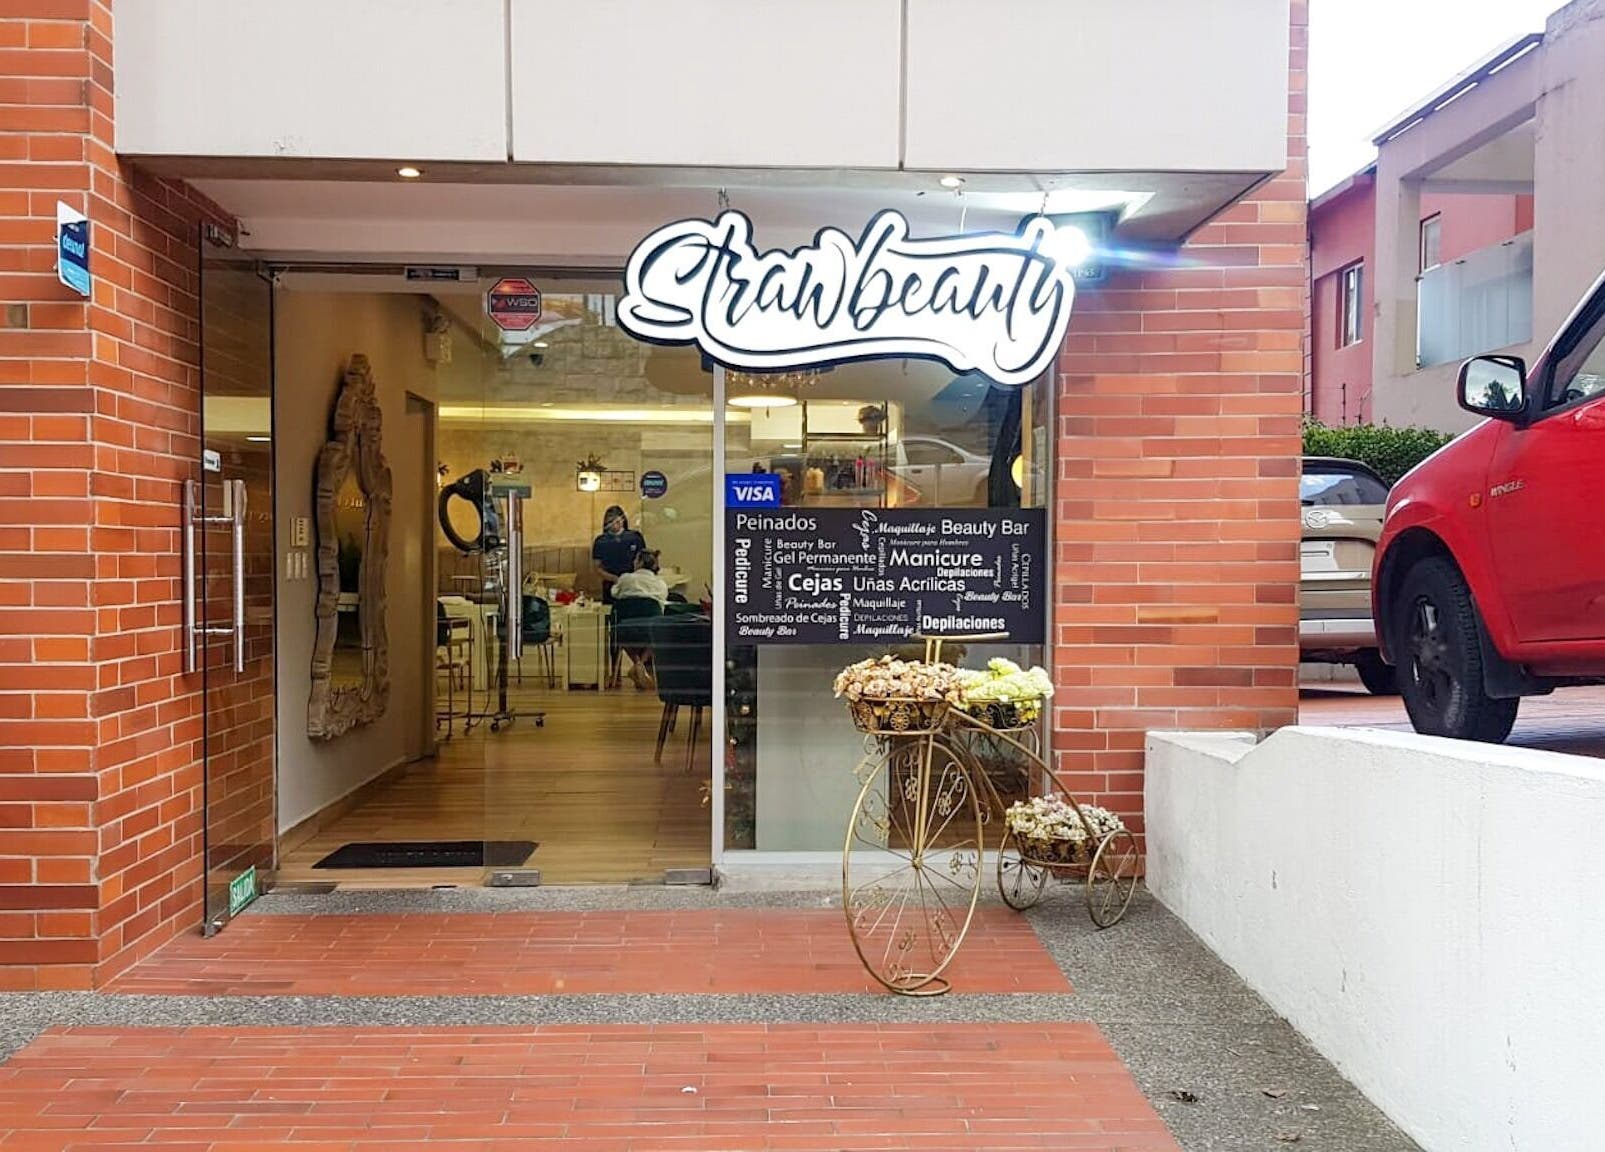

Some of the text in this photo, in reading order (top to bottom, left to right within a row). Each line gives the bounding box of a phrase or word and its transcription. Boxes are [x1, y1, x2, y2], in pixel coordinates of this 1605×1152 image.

[631, 221, 1064, 371] Strawbeauty
[733, 486, 774, 501] VISA
[736, 513, 817, 530] Peinados
[874, 522, 936, 536] Maquillaje
[942, 520, 1030, 538] Beauty Bar
[776, 539, 836, 551] Beauty Bar
[762, 538, 772, 589] Manicure
[774, 551, 876, 564] Gel Permanente
[878, 537, 886, 576] Cepillados
[889, 550, 983, 566] Manicure
[735, 538, 751, 604] Pedicure
[936, 567, 994, 580] Depilaciones
[788, 573, 843, 596] Cejas
[853, 576, 894, 592] Uñas
[785, 597, 838, 610] Peinados
[853, 598, 906, 610] Maquillaje
[964, 590, 1022, 604] Beauty Bar
[736, 612, 838, 624] Sombreado de Cejas
[839, 593, 852, 640] Pedicure
[922, 615, 1006, 632] Depilaciones
[738, 625, 797, 638] Beauty Bar
[853, 624, 915, 638] Maquillaje
